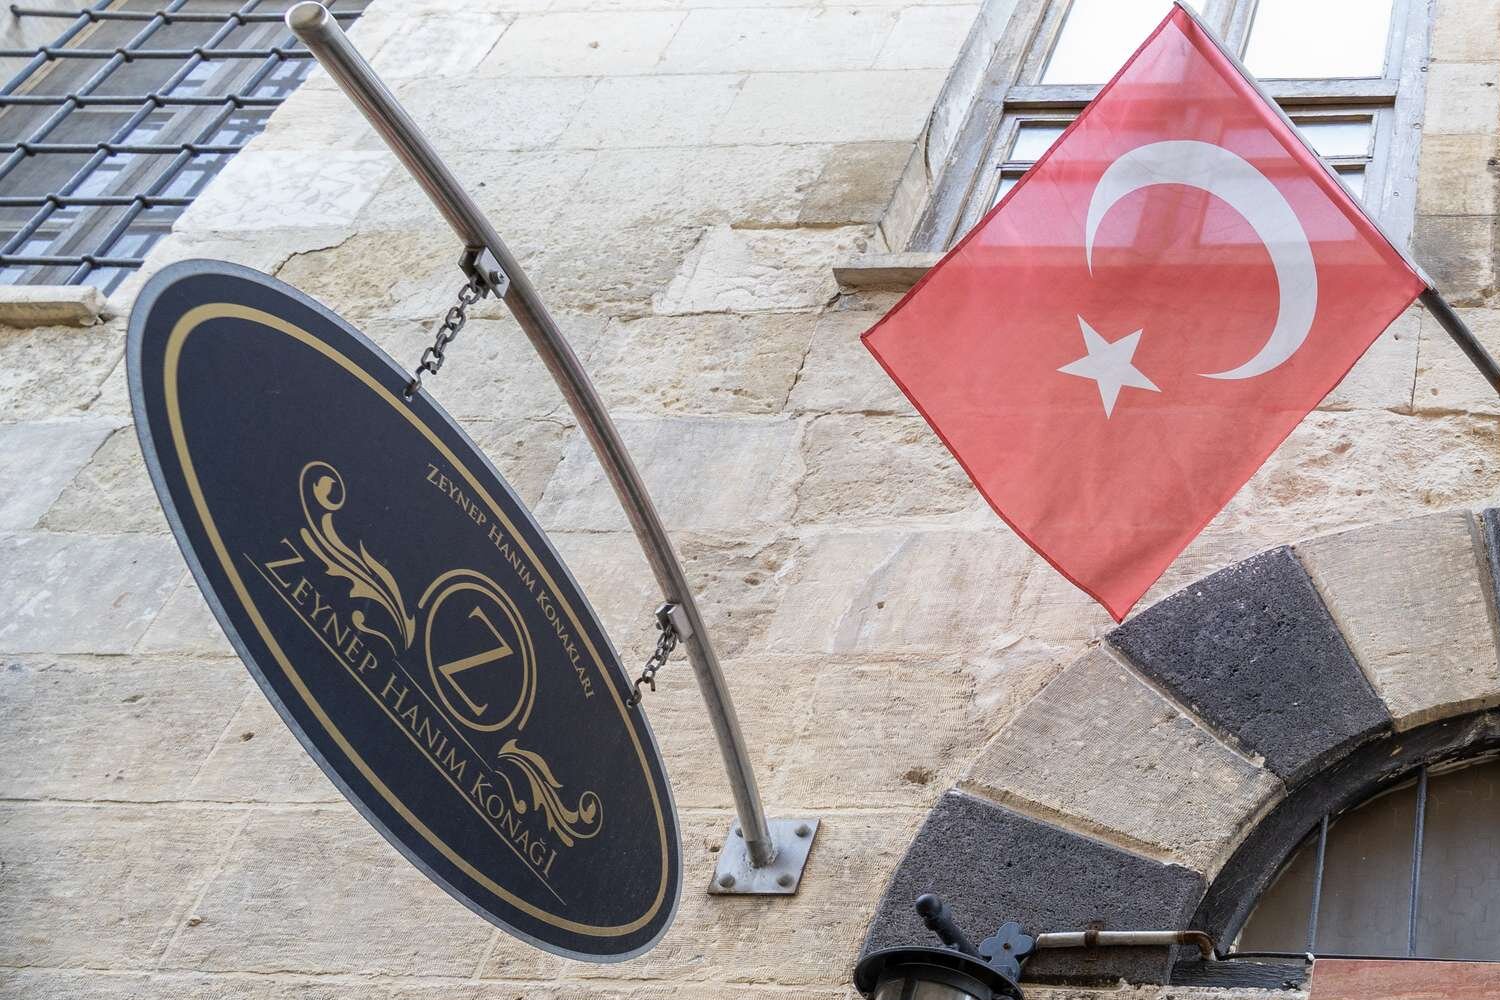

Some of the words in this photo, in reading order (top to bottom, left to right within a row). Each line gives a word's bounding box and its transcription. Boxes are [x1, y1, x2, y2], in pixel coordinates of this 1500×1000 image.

[265, 538, 378, 674] ZEYNEP
[380, 673, 468, 780] HANIM
[470, 773, 559, 879] KONAĞI
[426, 463, 488, 527] ZEYNEP
[488, 523, 536, 592] HANIM
[536, 589, 595, 699] KONAKLARI
